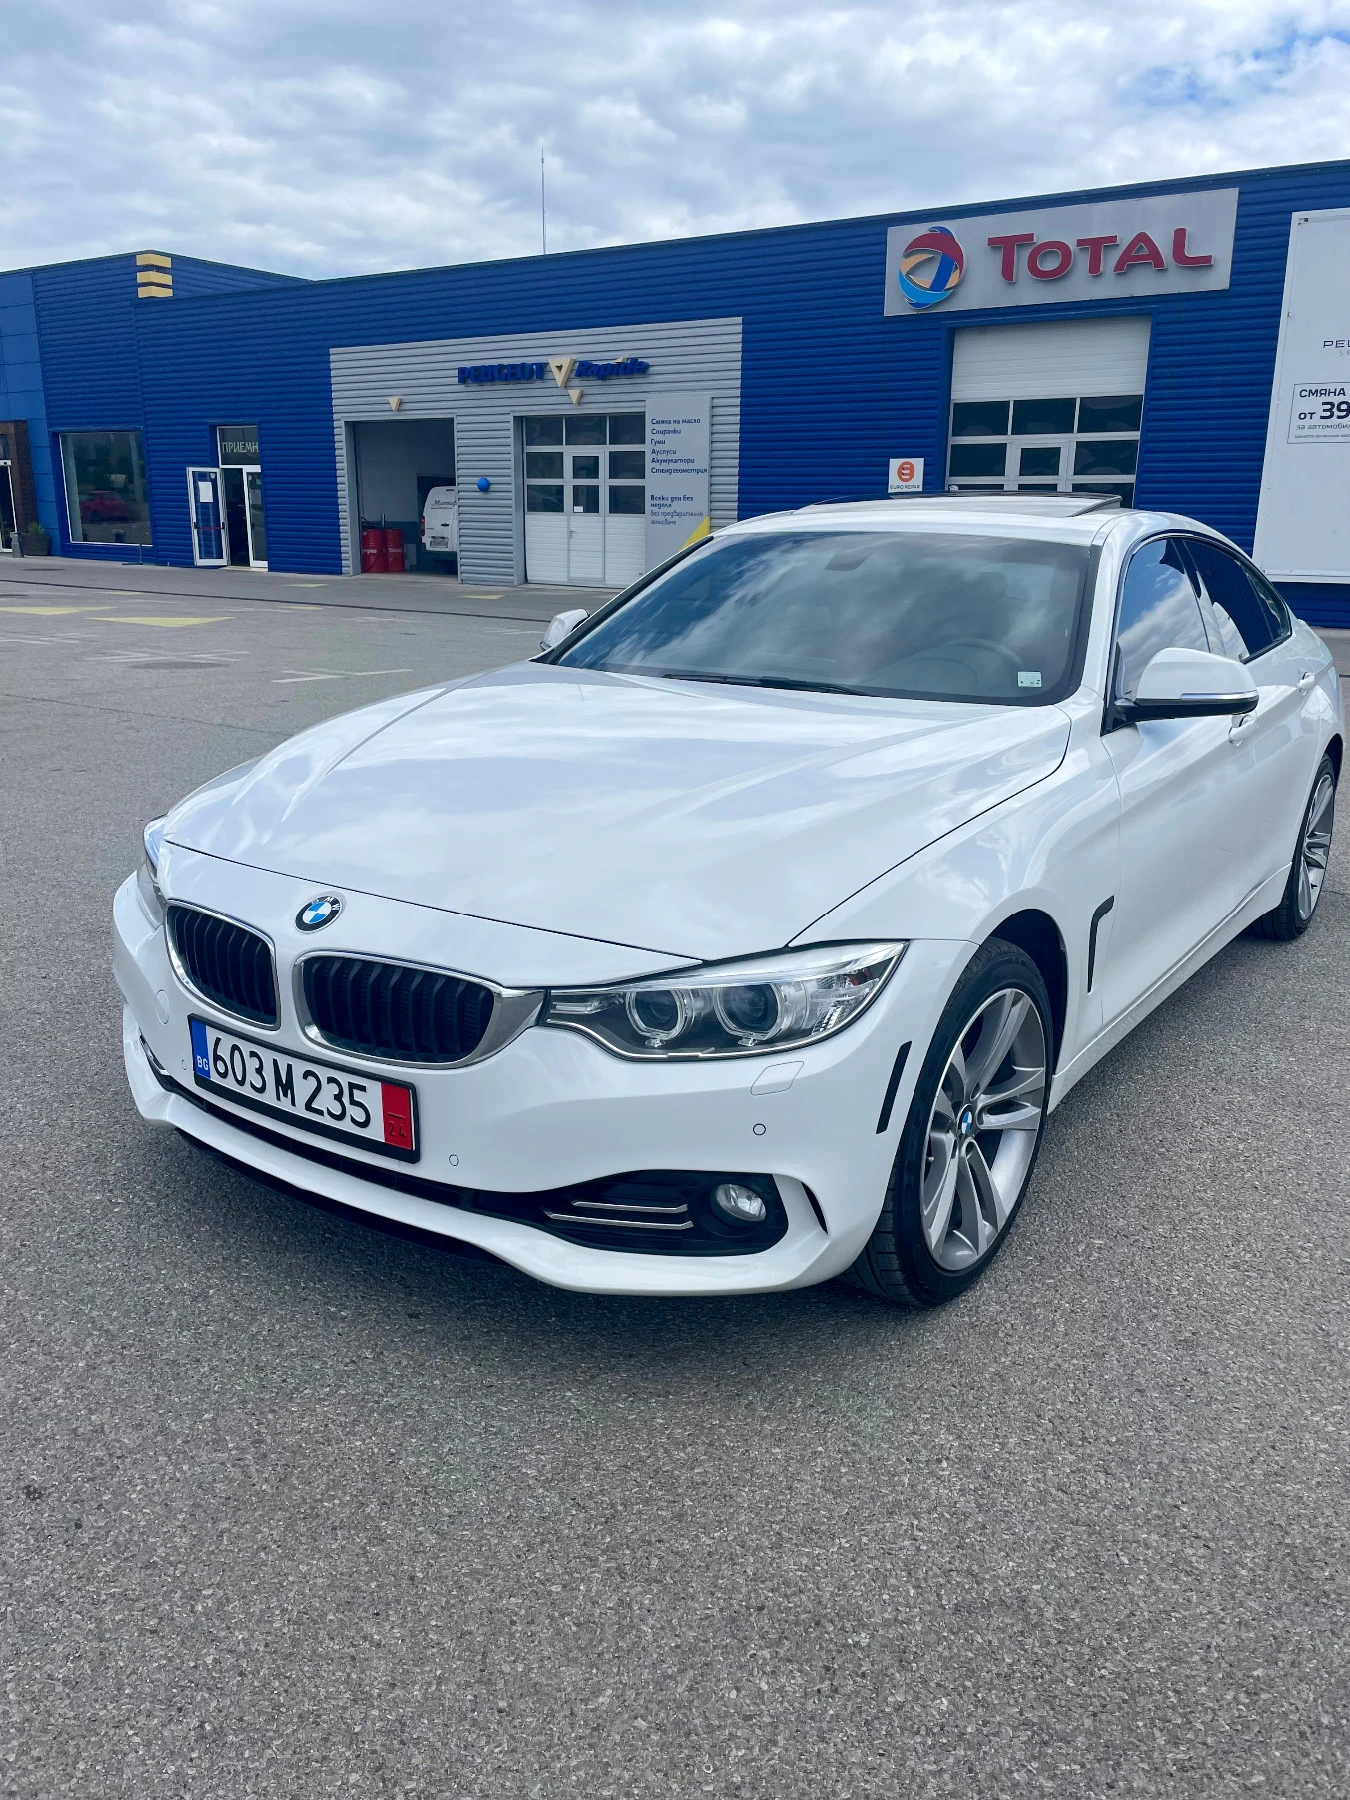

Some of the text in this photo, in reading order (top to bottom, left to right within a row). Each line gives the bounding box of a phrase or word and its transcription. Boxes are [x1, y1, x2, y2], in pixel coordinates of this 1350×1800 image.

[457, 362, 548, 383] PEUGEOT
[1299, 388, 1346, 398] СМЯНА
[650, 438, 666, 446] Гуми
[651, 448, 677, 456] Ауспуси
[196, 1055, 209, 1071] BG
[212, 1036, 267, 1094] 603
[302, 1069, 371, 1129] 235
